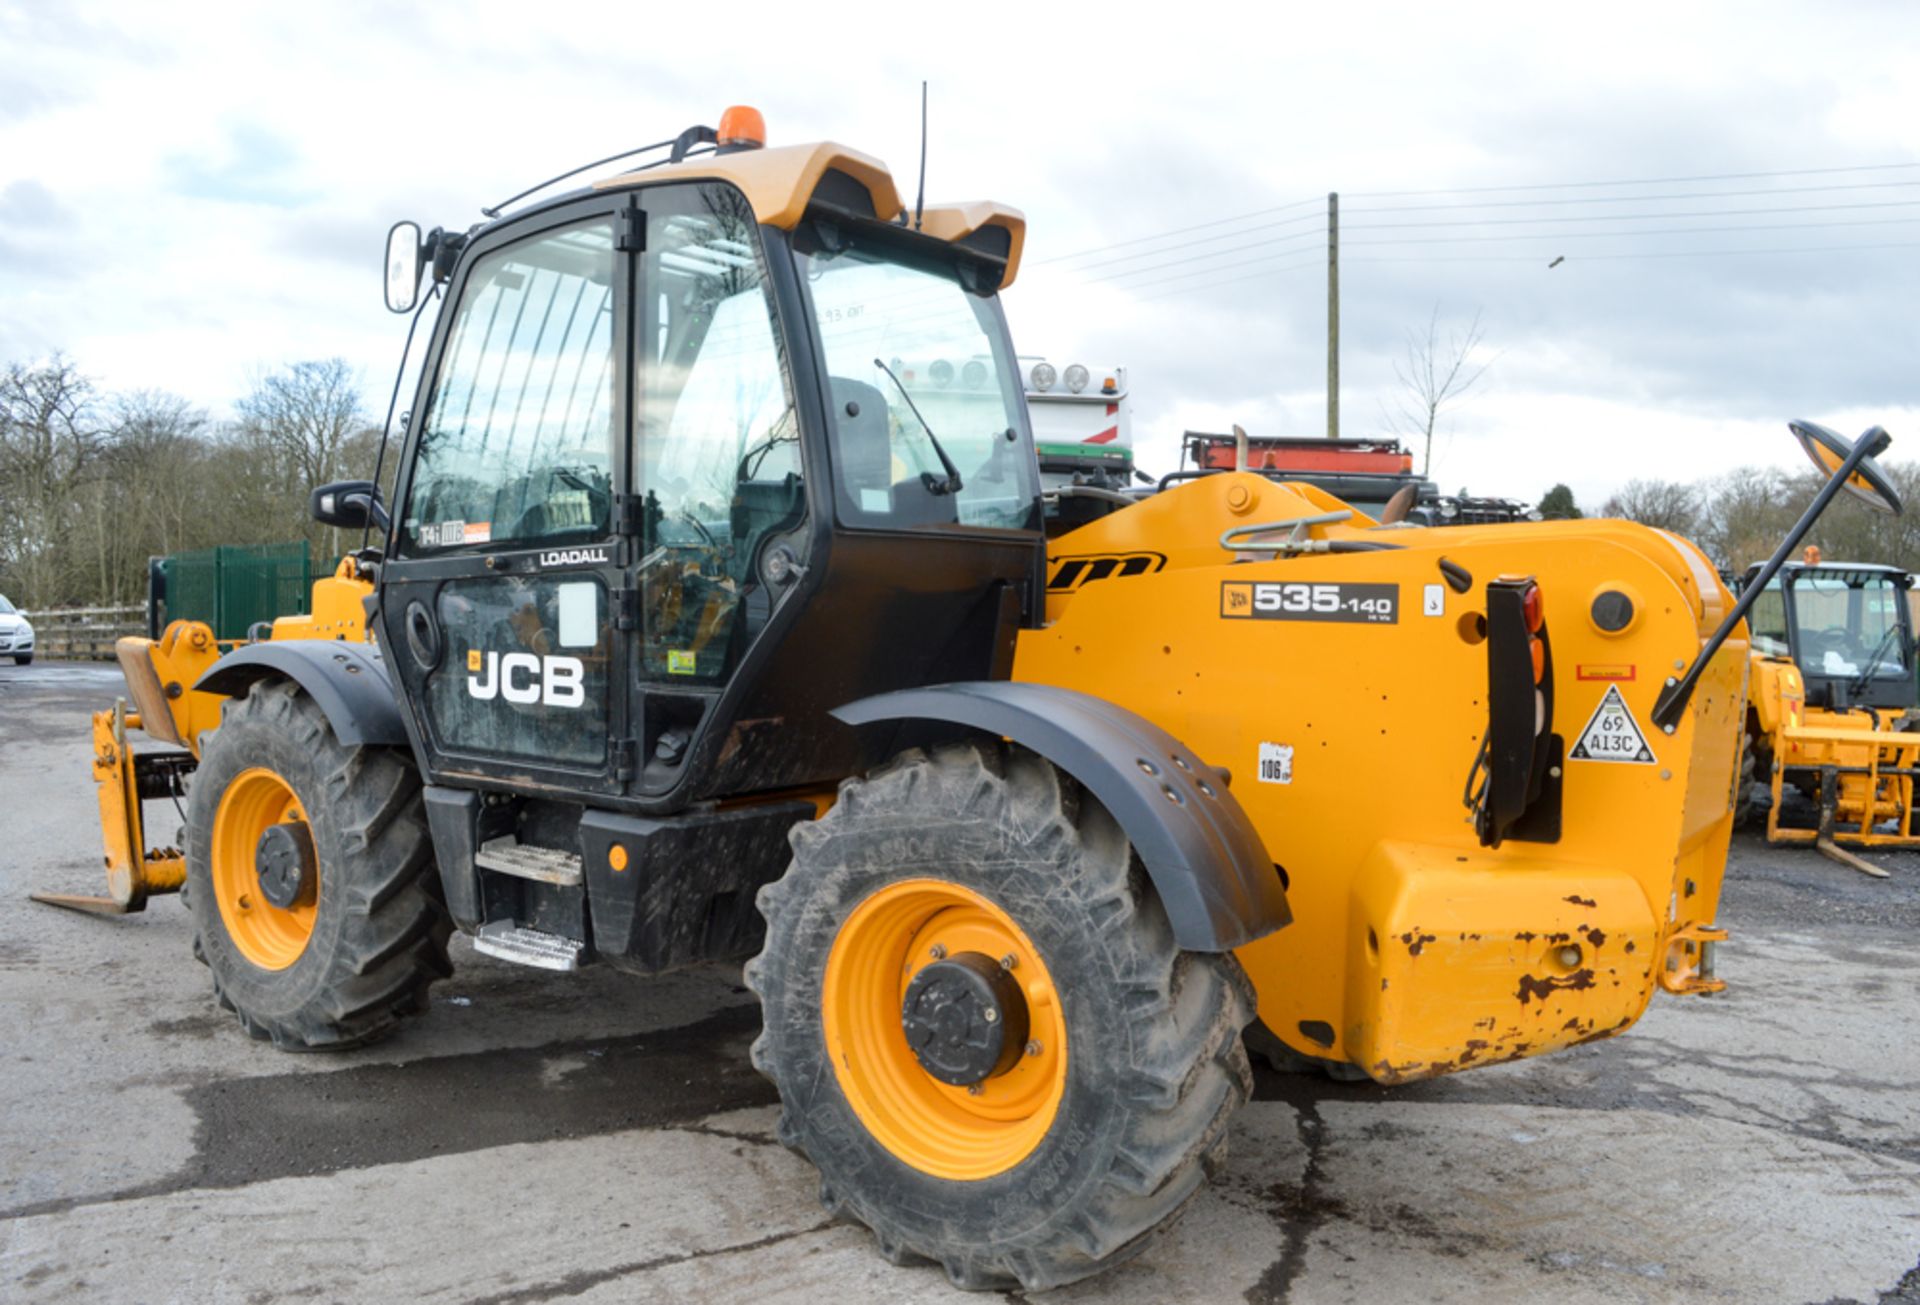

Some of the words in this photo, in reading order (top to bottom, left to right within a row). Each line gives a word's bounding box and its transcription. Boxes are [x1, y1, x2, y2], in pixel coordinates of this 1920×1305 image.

[540, 548, 608, 567] LOADALL
[467, 651, 585, 708] JCB
[1602, 716, 1624, 731] 69
[1261, 759, 1281, 779] 106
